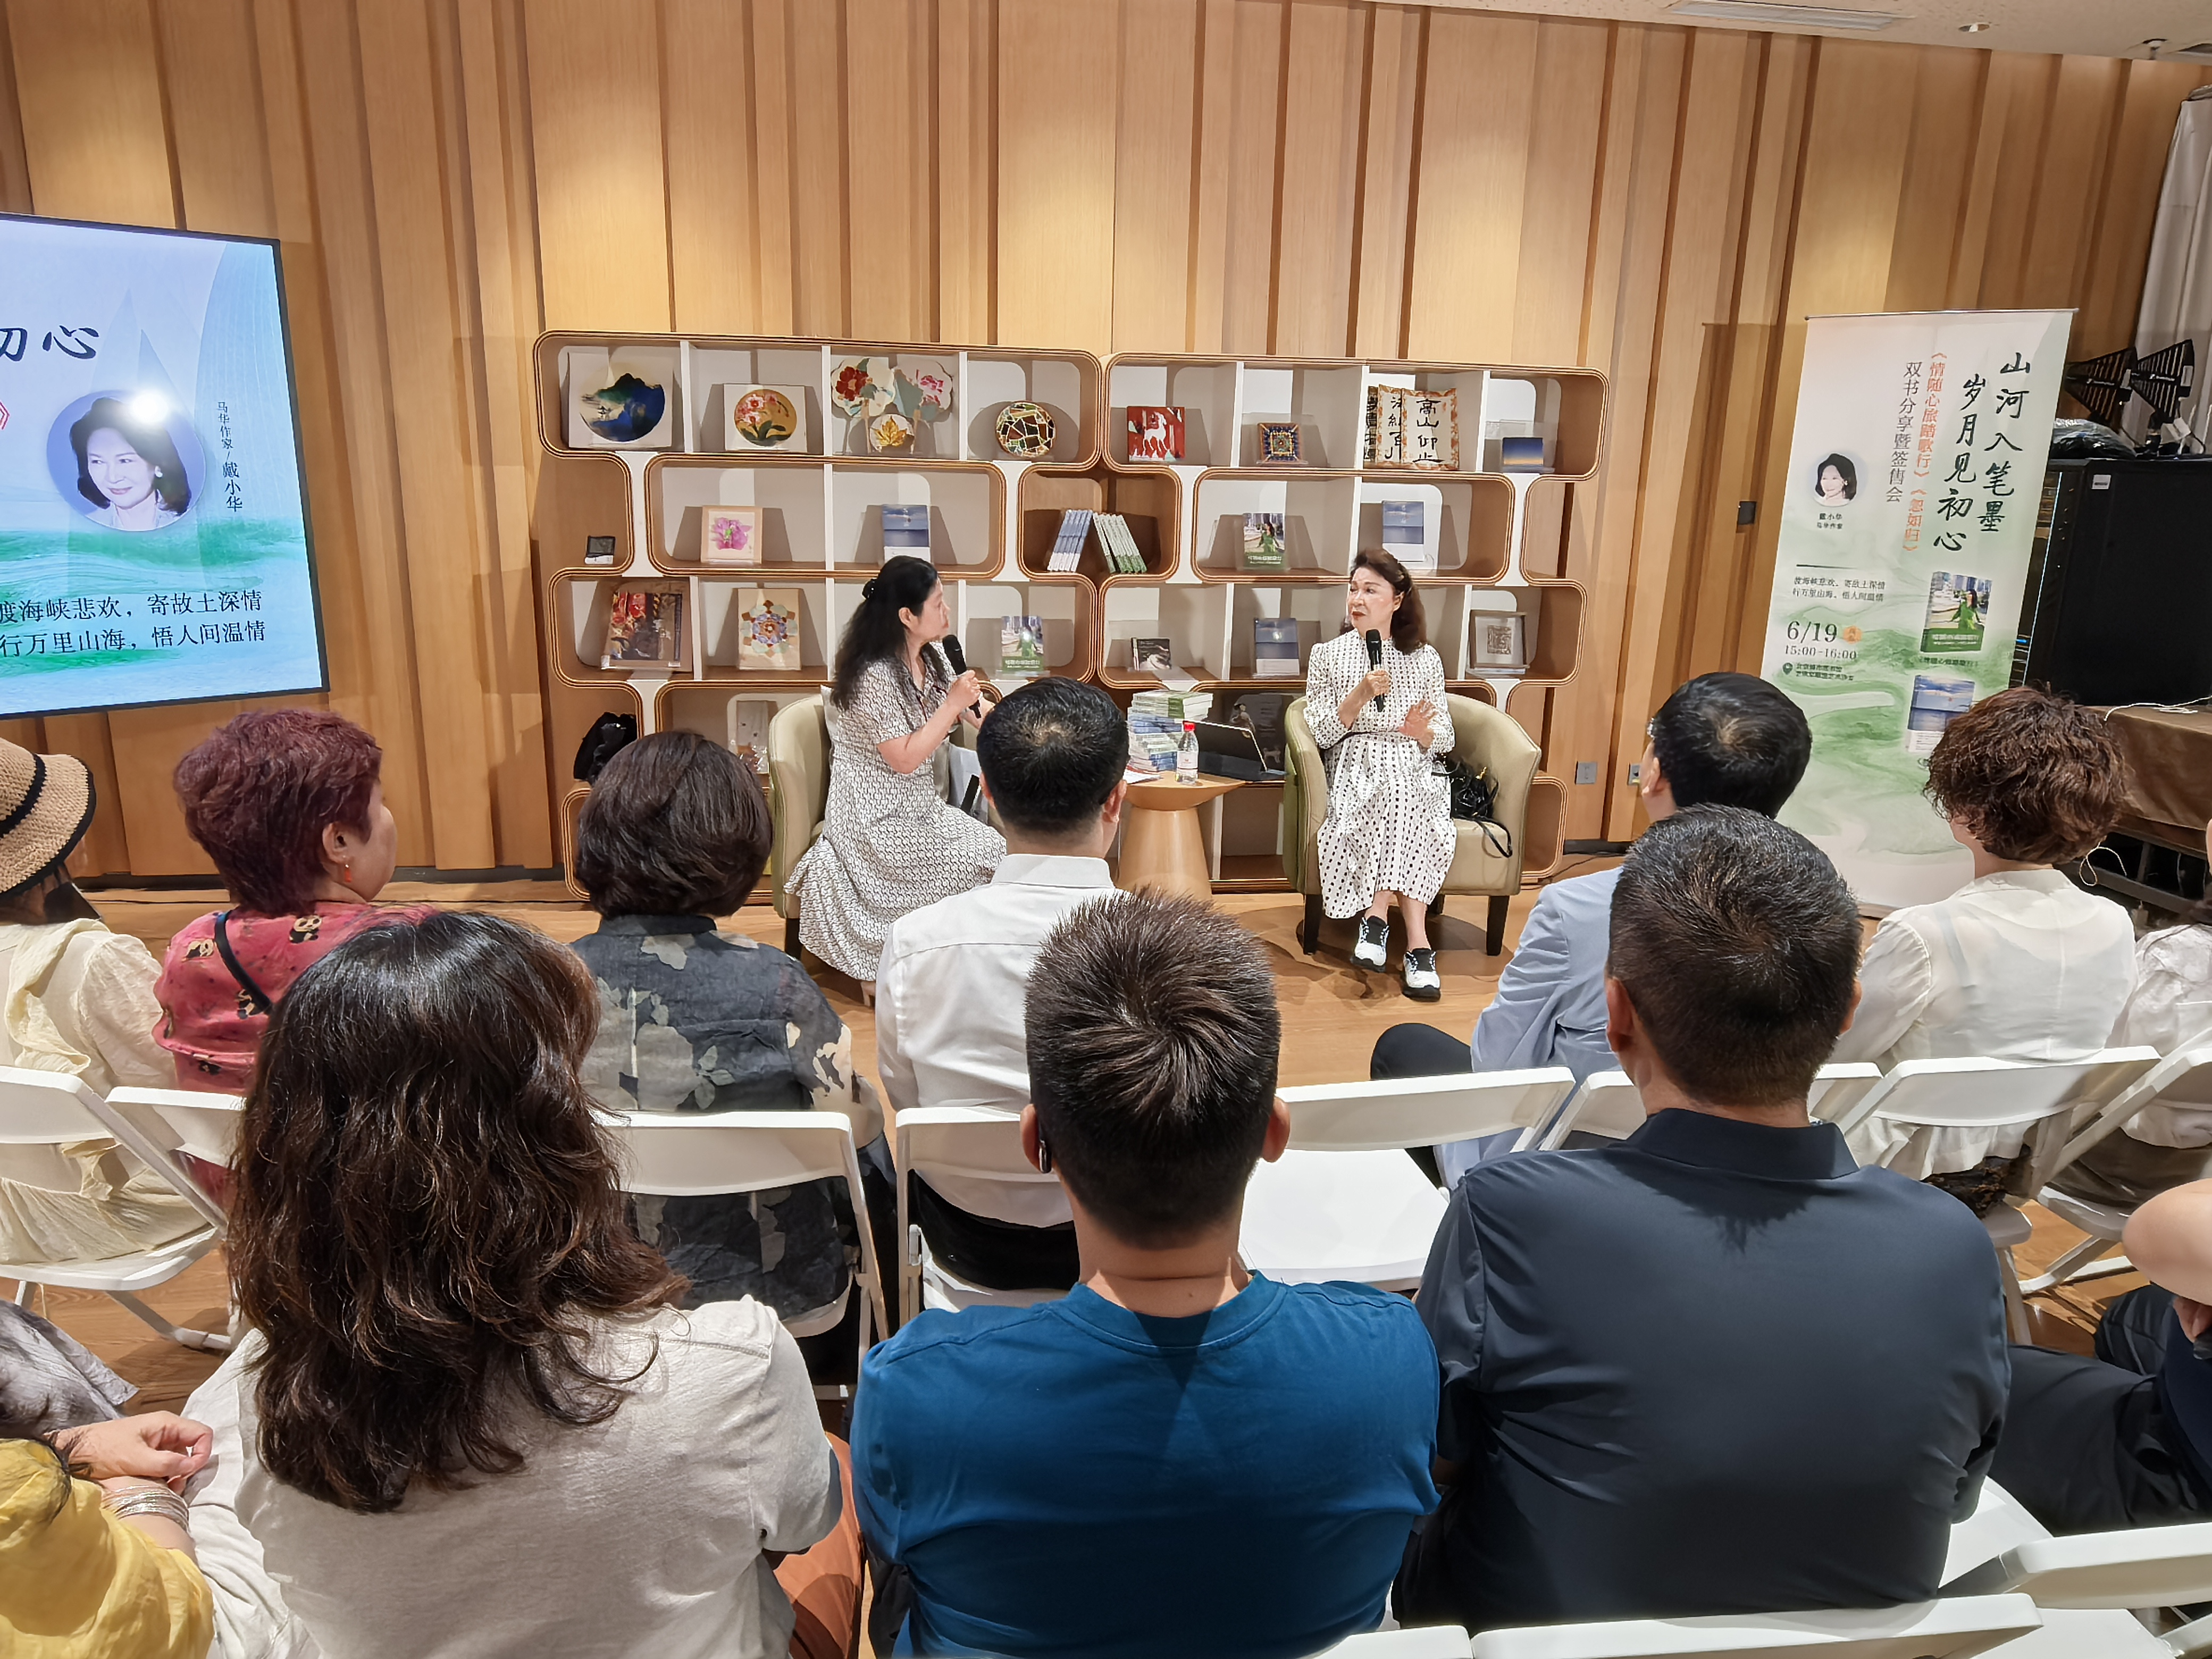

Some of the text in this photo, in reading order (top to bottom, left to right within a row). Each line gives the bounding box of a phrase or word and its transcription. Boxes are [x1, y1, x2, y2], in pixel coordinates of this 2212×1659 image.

[1412, 399, 1445, 463] 高山仰止
[1886, 361, 1922, 502] 双书分享暨签售会
[1933, 373, 1987, 551] 岁月见初心
[1976, 351, 2031, 532] 山河入笔墨
[1785, 645, 1857, 659] 15:00-16:00
[1787, 621, 1837, 643] 6/19
